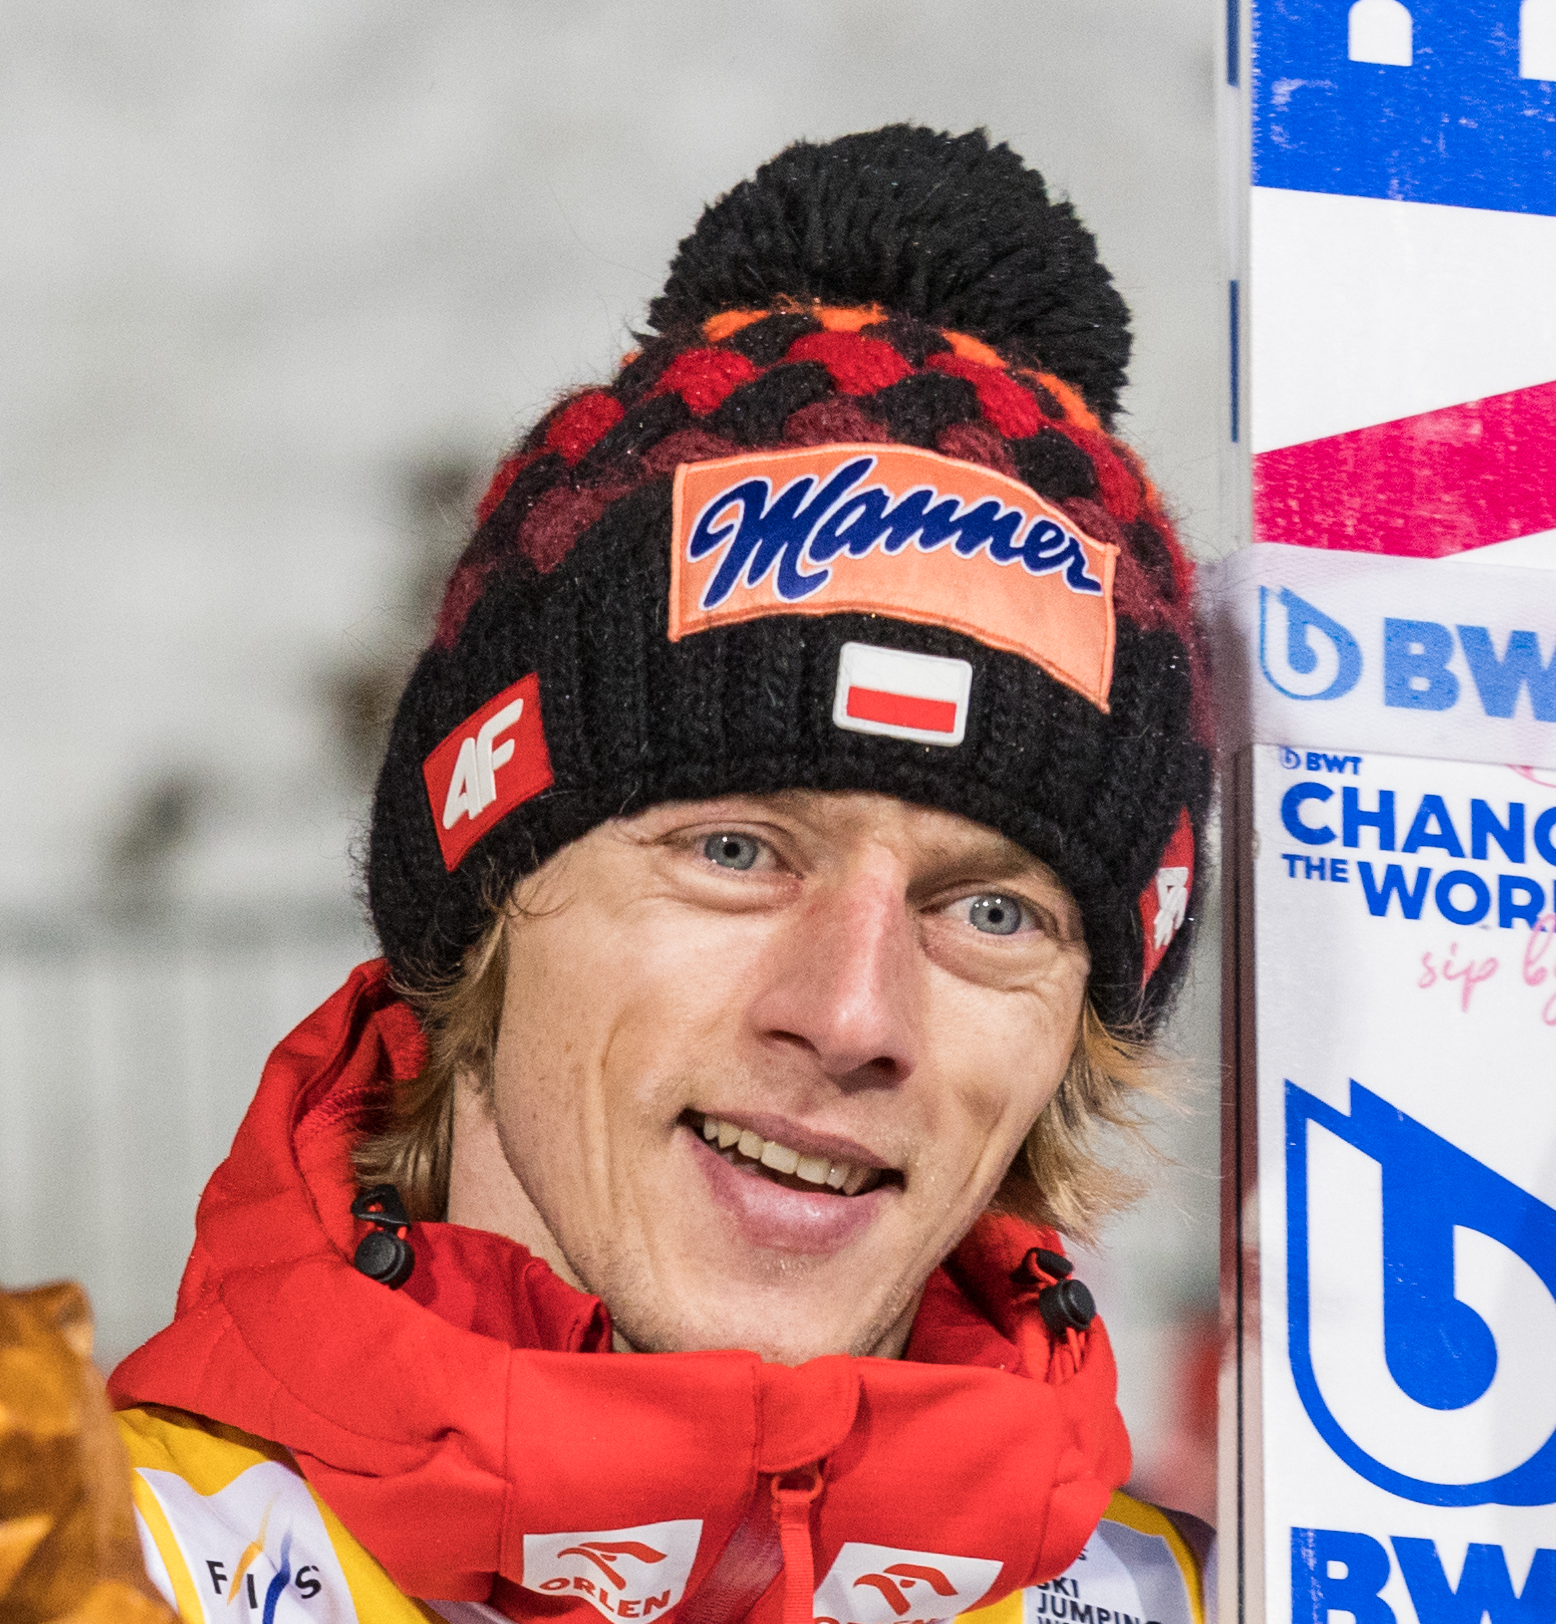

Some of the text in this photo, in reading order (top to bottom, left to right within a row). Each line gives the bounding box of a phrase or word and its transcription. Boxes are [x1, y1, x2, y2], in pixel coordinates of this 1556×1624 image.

[688, 455, 1103, 610] Manner
[1384, 617, 1556, 723] BW
[442, 697, 526, 832] 4F
[1306, 752, 1362, 775] BWT
[1281, 853, 1556, 932] THE WOR
[1417, 941, 1498, 1013] sip
[206, 1560, 322, 1609] FIS
[538, 1576, 671, 1620] ORLEN
